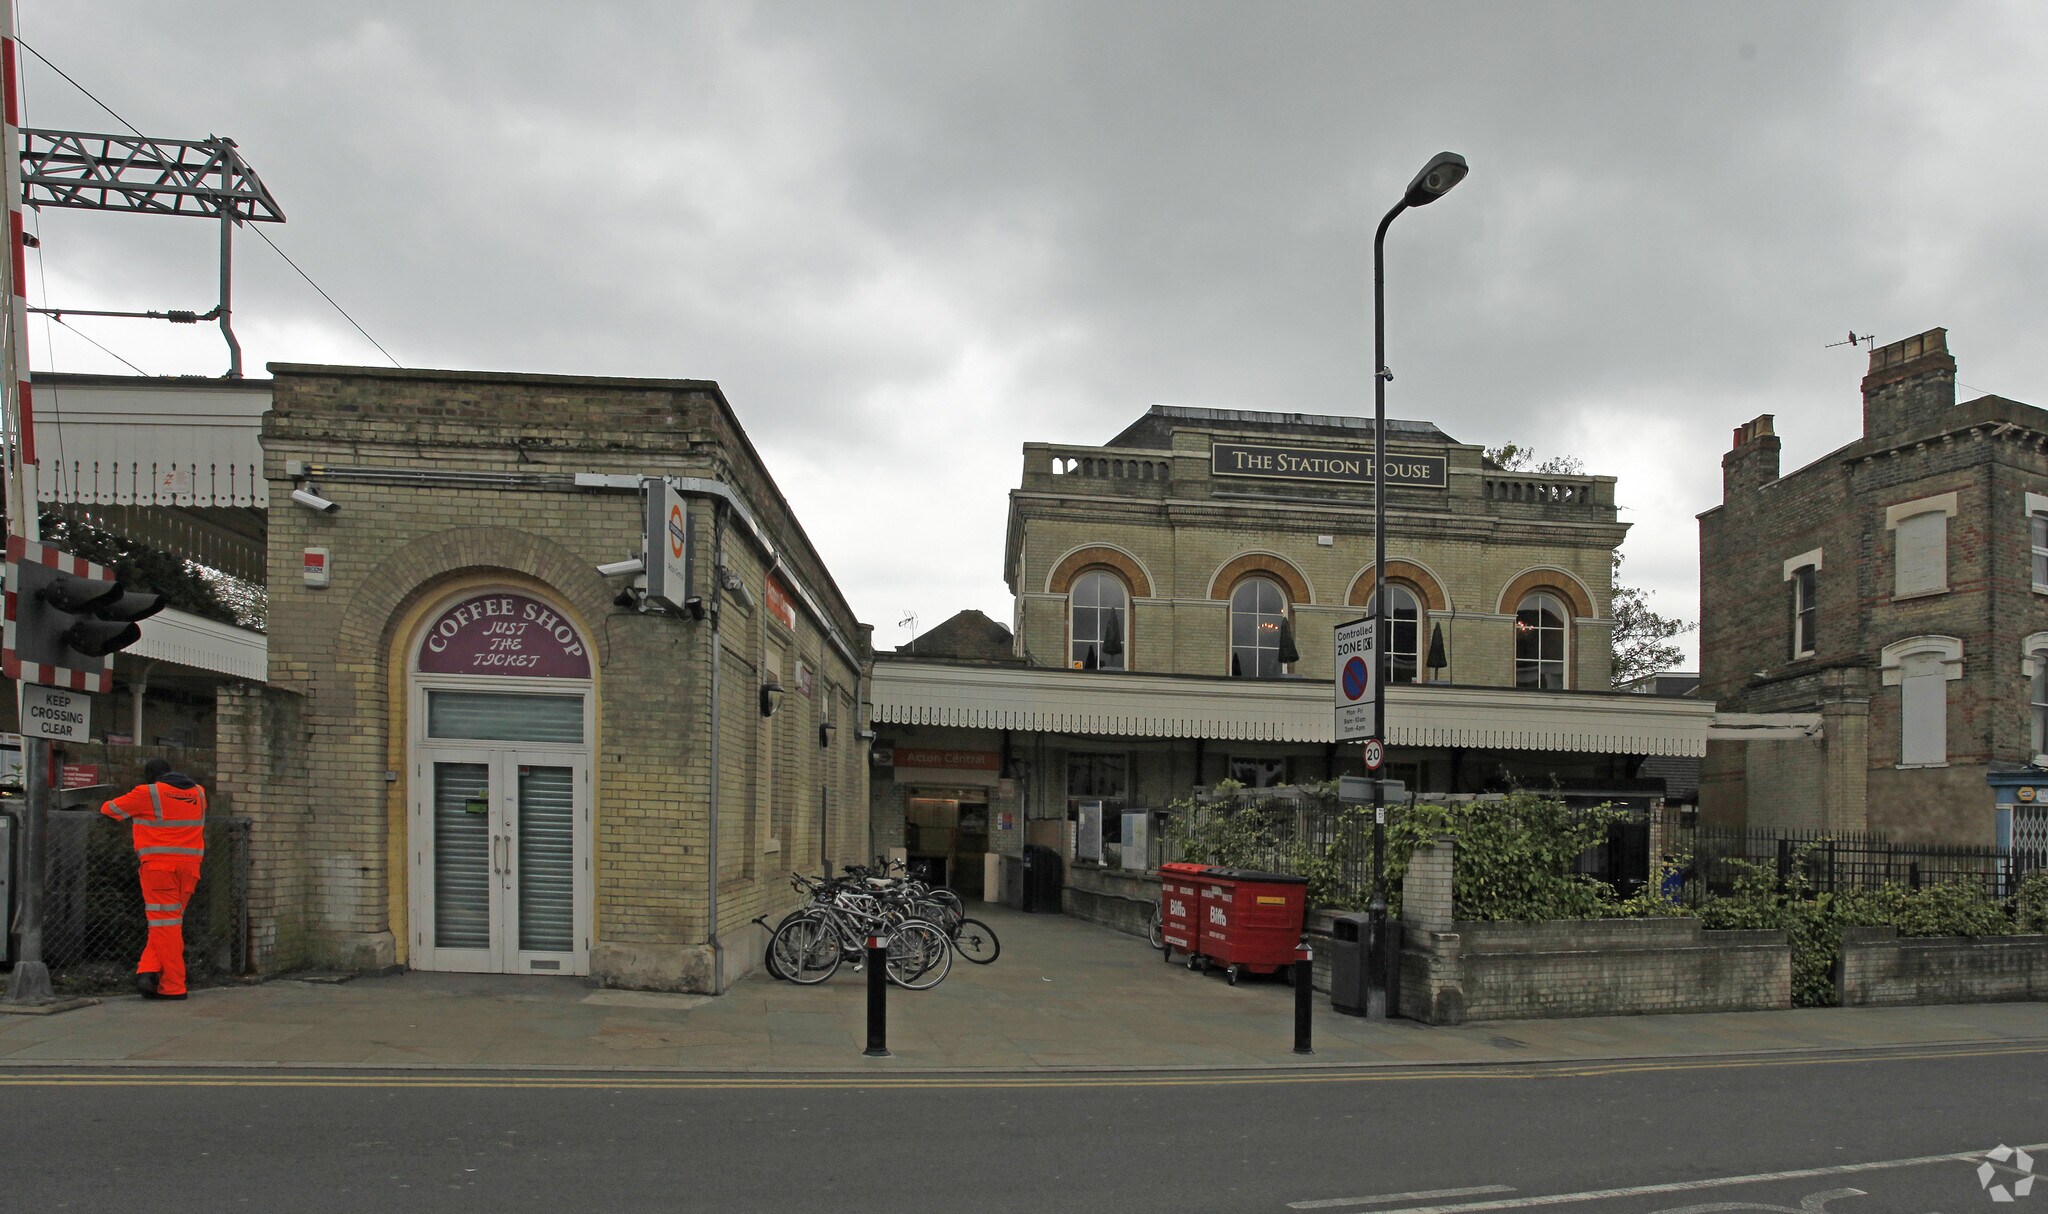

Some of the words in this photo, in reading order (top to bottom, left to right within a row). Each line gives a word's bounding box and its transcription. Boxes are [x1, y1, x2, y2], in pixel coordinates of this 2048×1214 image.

[1232, 450, 1273, 469] THE
[1277, 453, 1360, 475] STATION
[428, 598, 515, 653] COFFEE
[523, 603, 583, 658] SHOP
[482, 621, 529, 636] JUST
[1337, 624, 1373, 642] Controlled
[489, 637, 522, 651] THE
[1337, 640, 1362, 656] ZONE
[473, 653, 540, 668] TICKET
[46, 693, 71, 708] KEEP
[31, 706, 84, 725] CROSSING
[41, 722, 73, 737] CLEAR
[907, 753, 941, 762] Acton
[944, 753, 986, 765] Central
[1366, 748, 1380, 761] 20
[1170, 898, 1186, 918] Biffa
[1209, 905, 1227, 927] Biffa
